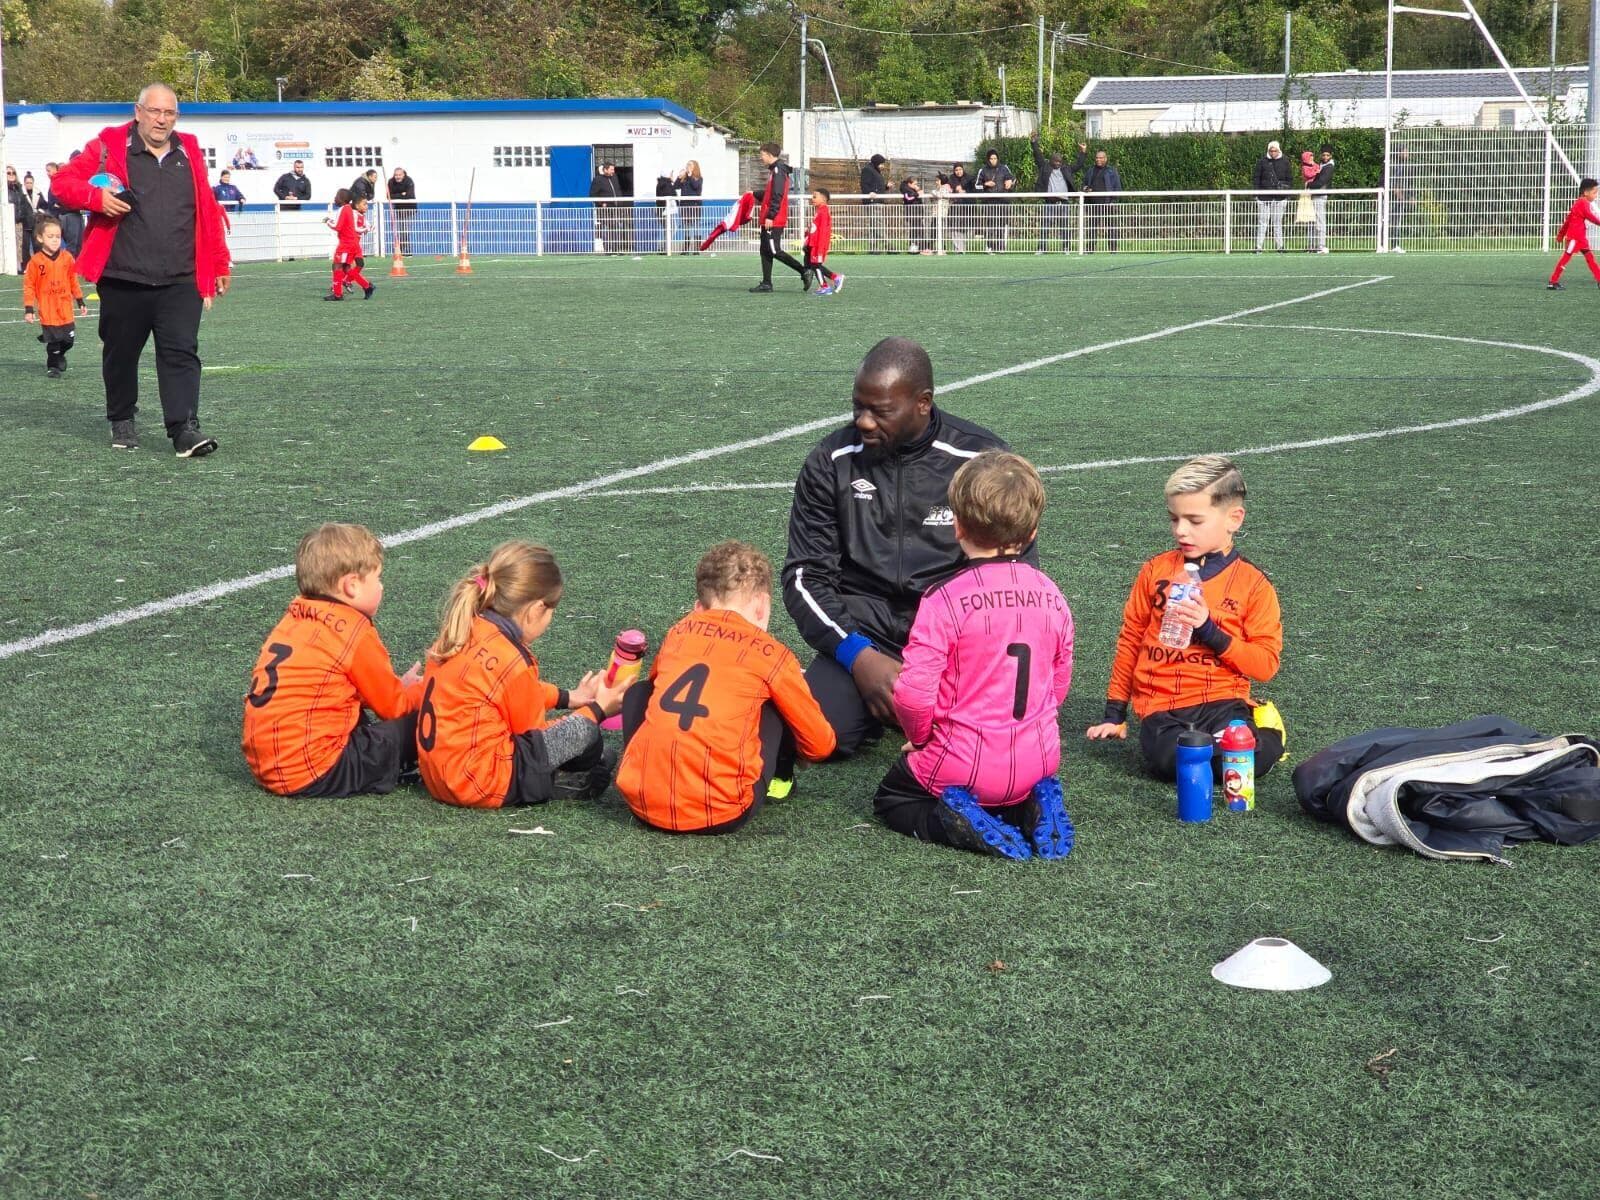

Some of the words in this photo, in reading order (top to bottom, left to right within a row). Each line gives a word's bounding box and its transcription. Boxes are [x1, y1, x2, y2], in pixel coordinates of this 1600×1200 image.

[959, 590, 1042, 614] FONTENAY
[1151, 579, 1170, 610] 3
[248, 642, 293, 709] 3
[660, 663, 710, 732] 4
[1006, 642, 1031, 721] 1
[418, 676, 437, 752] 6
